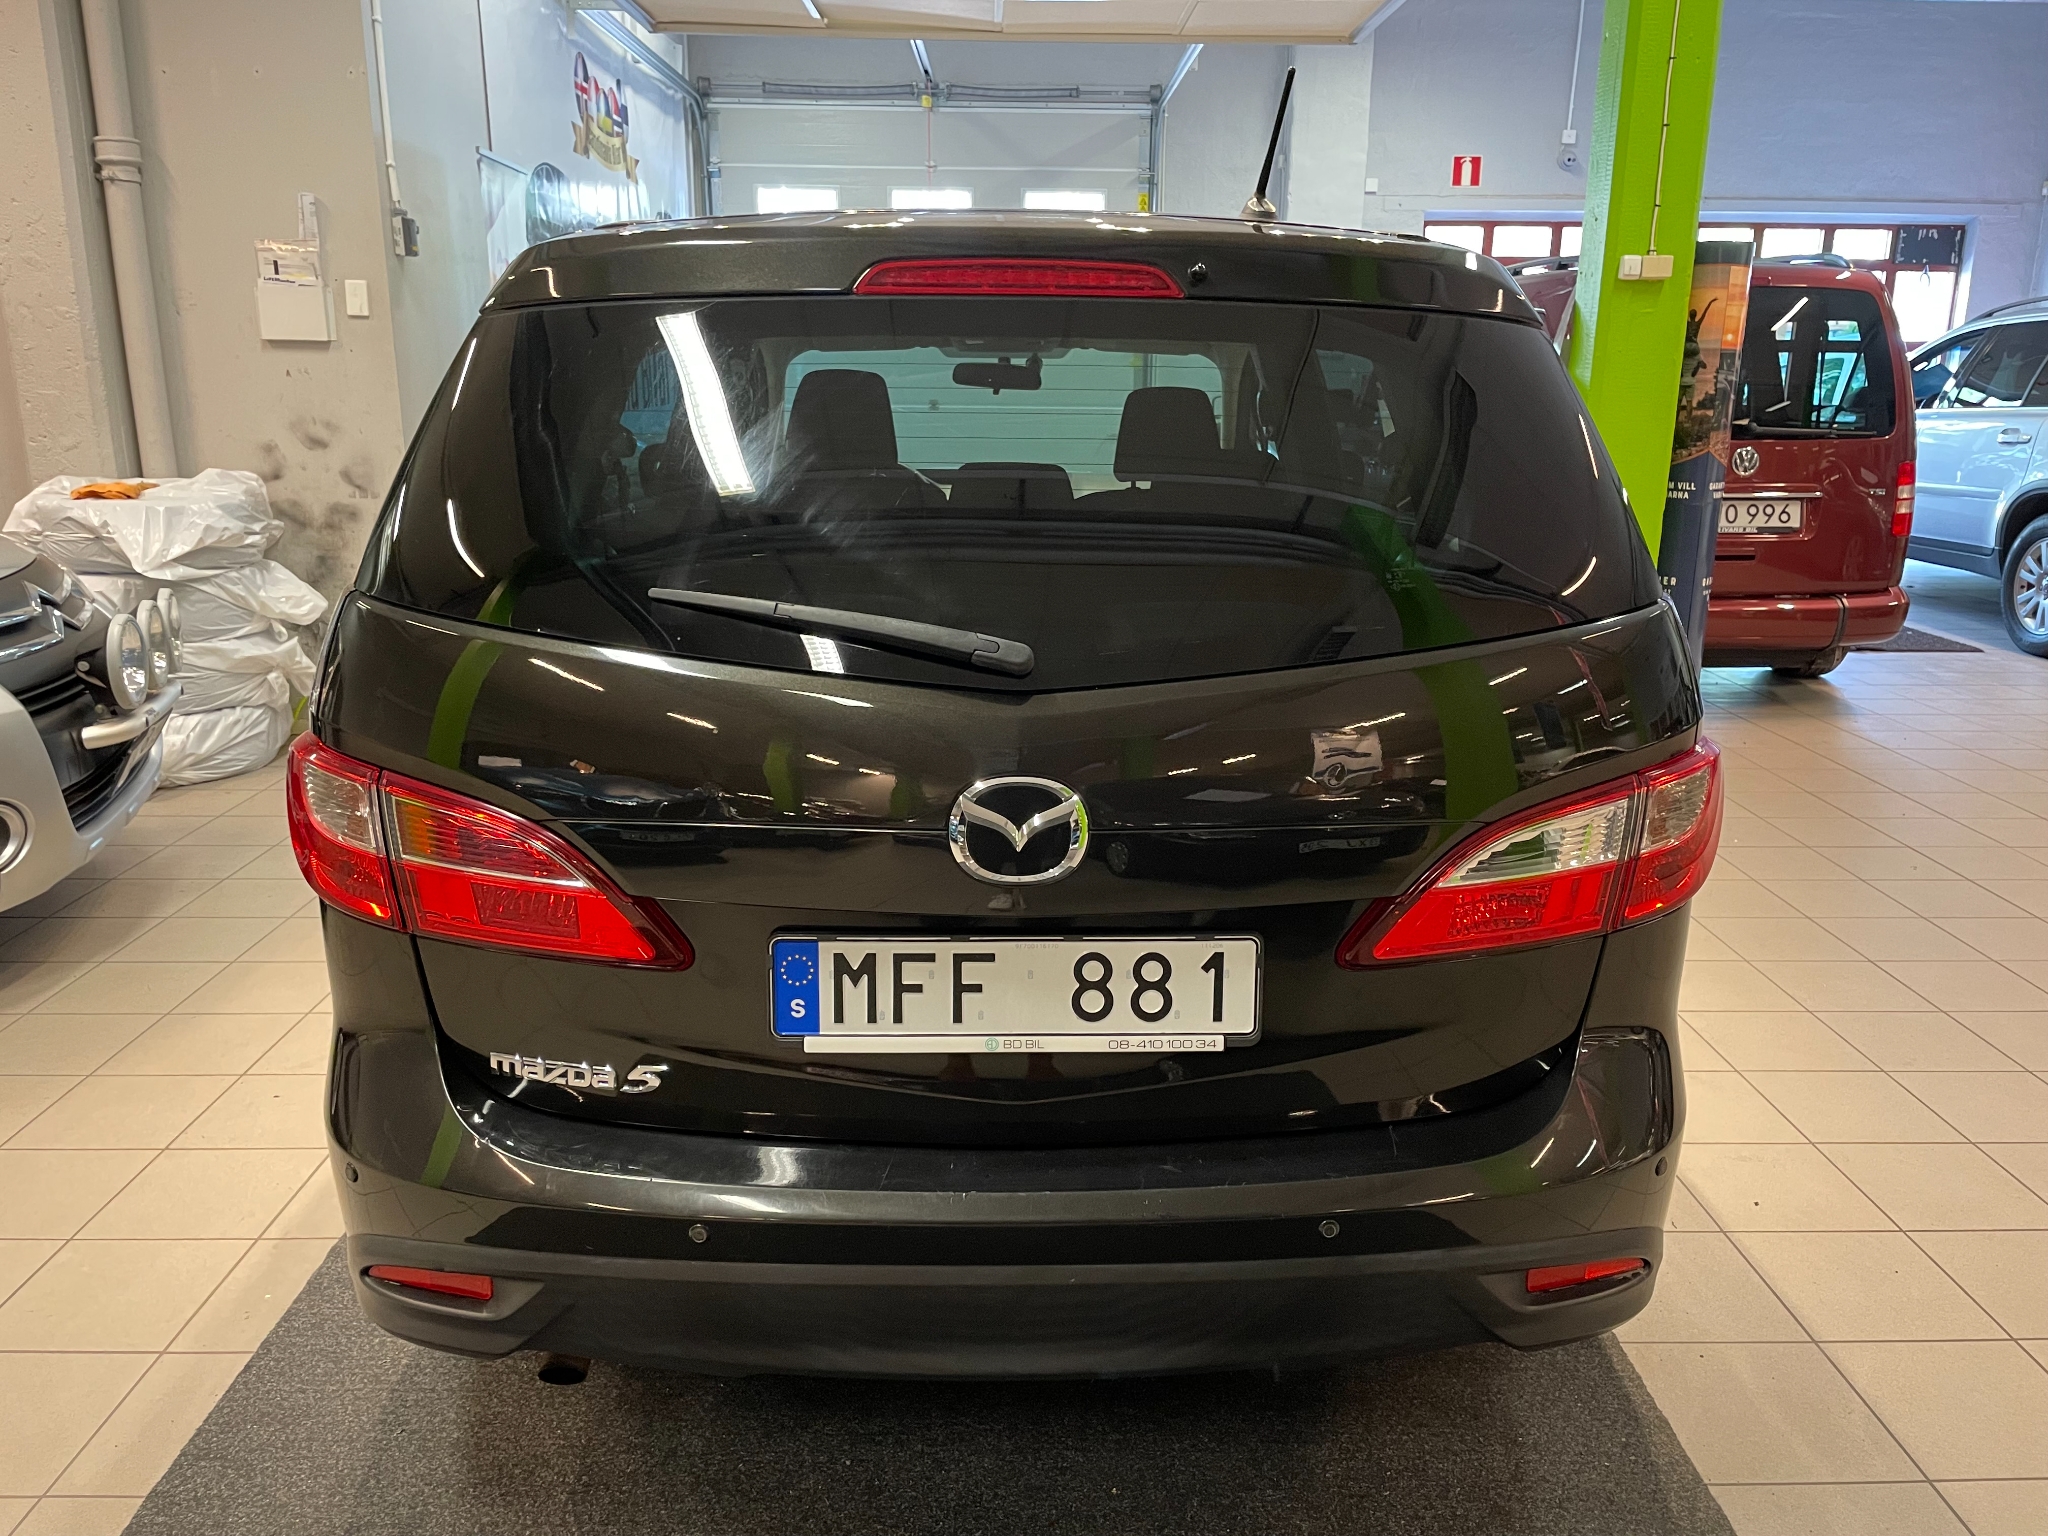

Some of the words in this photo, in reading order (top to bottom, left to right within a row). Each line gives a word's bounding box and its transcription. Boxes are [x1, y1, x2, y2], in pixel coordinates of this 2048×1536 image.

[1677, 481, 1697, 491] VILL
[1746, 503, 1792, 525] 996
[1658, 576, 1678, 587] ER
[832, 952, 996, 1024] MFF
[1070, 951, 1226, 1024] 881
[790, 998, 806, 1019] S
[1003, 1039, 1023, 1049] BD
[1025, 1039, 1045, 1049] BIL
[1195, 1039, 1217, 1049] 34
